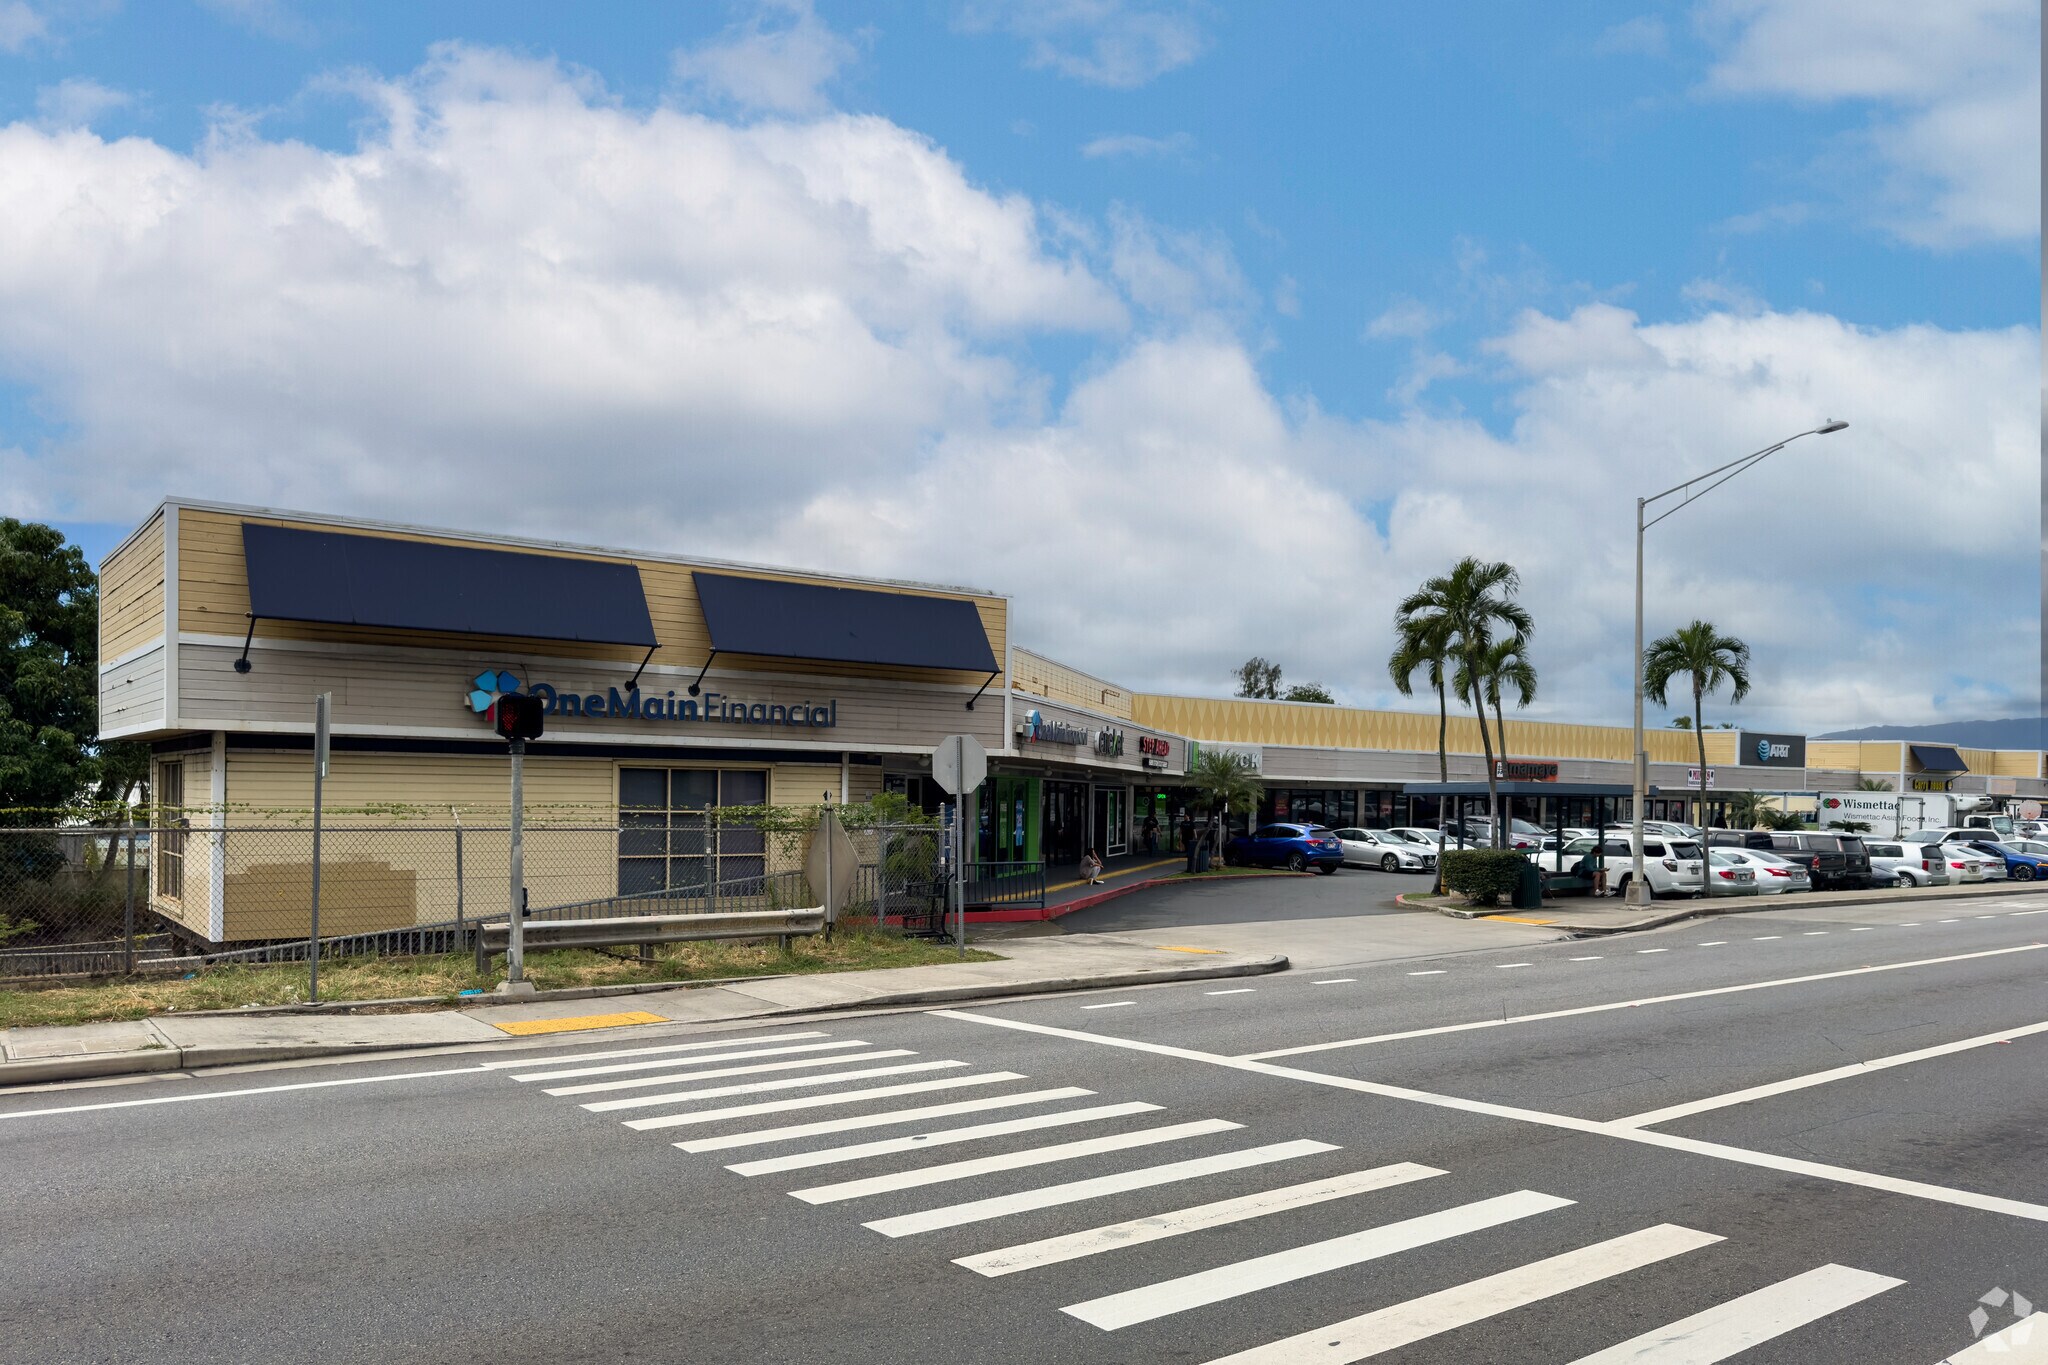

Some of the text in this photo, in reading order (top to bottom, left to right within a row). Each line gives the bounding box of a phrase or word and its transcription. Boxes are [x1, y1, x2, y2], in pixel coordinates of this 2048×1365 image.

[1769, 743, 1791, 758] AT&T
[1843, 798, 1900, 811] Wismettac
[1843, 812, 1880, 821] Wismettac
